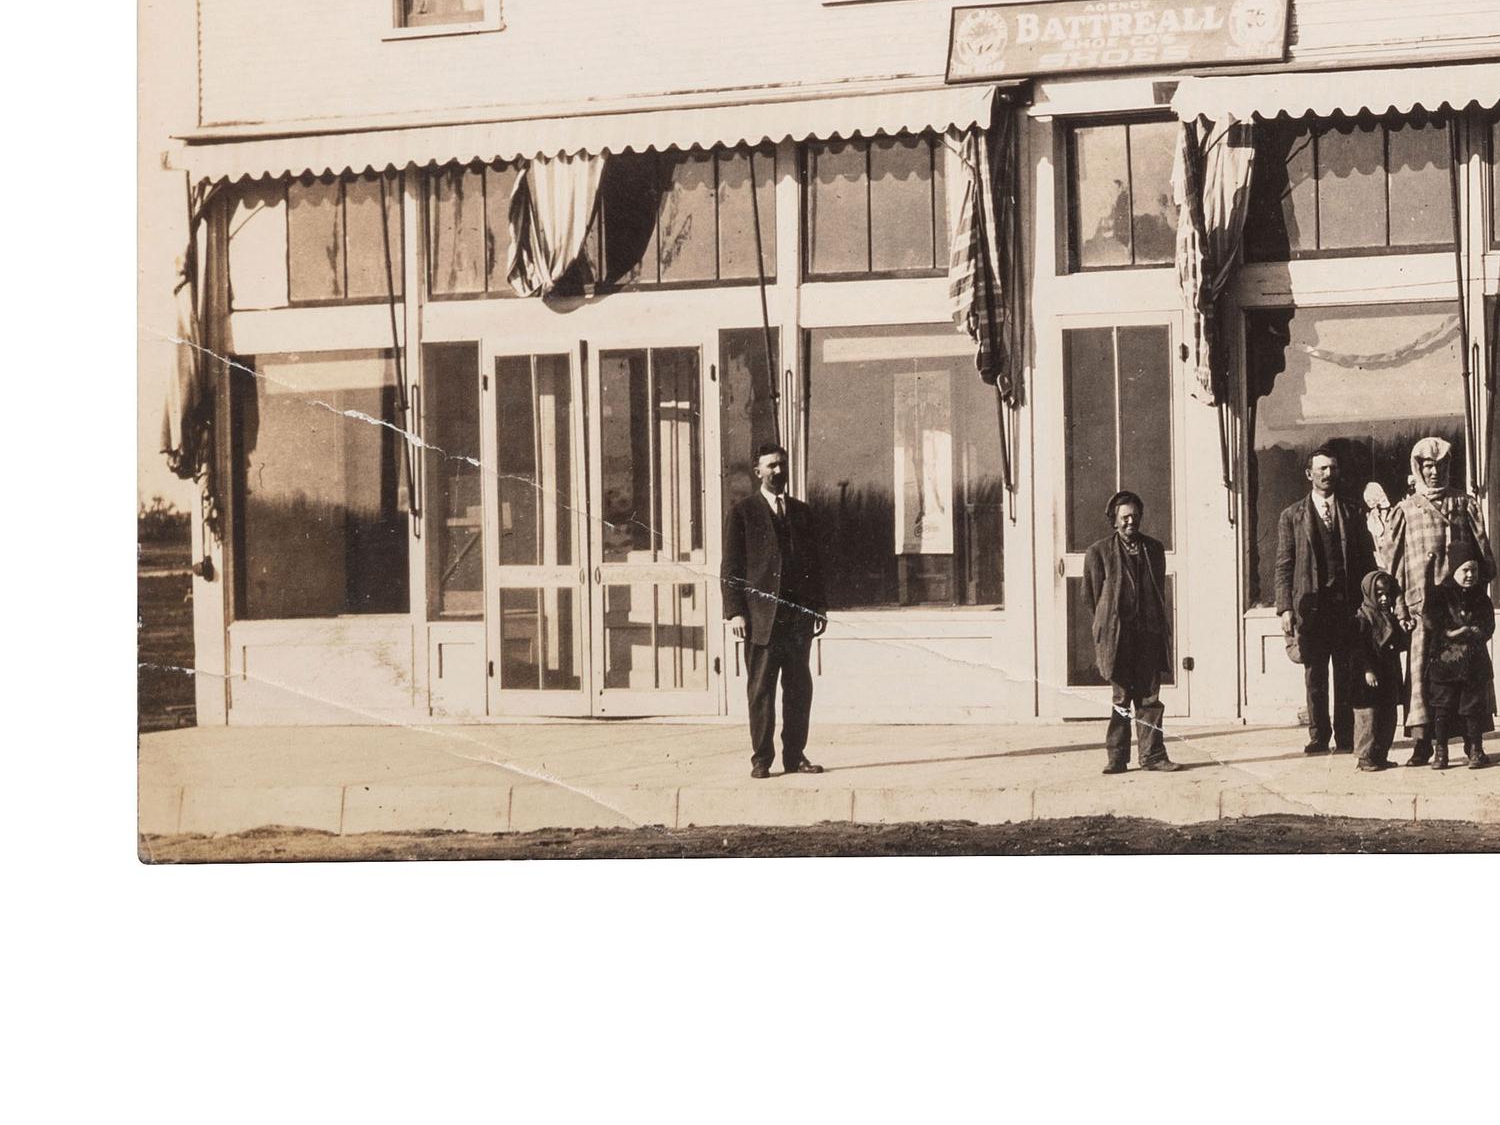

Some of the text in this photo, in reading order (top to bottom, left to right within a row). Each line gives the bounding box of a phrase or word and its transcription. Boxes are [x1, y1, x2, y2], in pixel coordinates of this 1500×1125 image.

[1084, 0, 1150, 13] AGENCY
[1016, 6, 1225, 44] BATTREALL
[1037, 44, 1192, 69] SHOES
